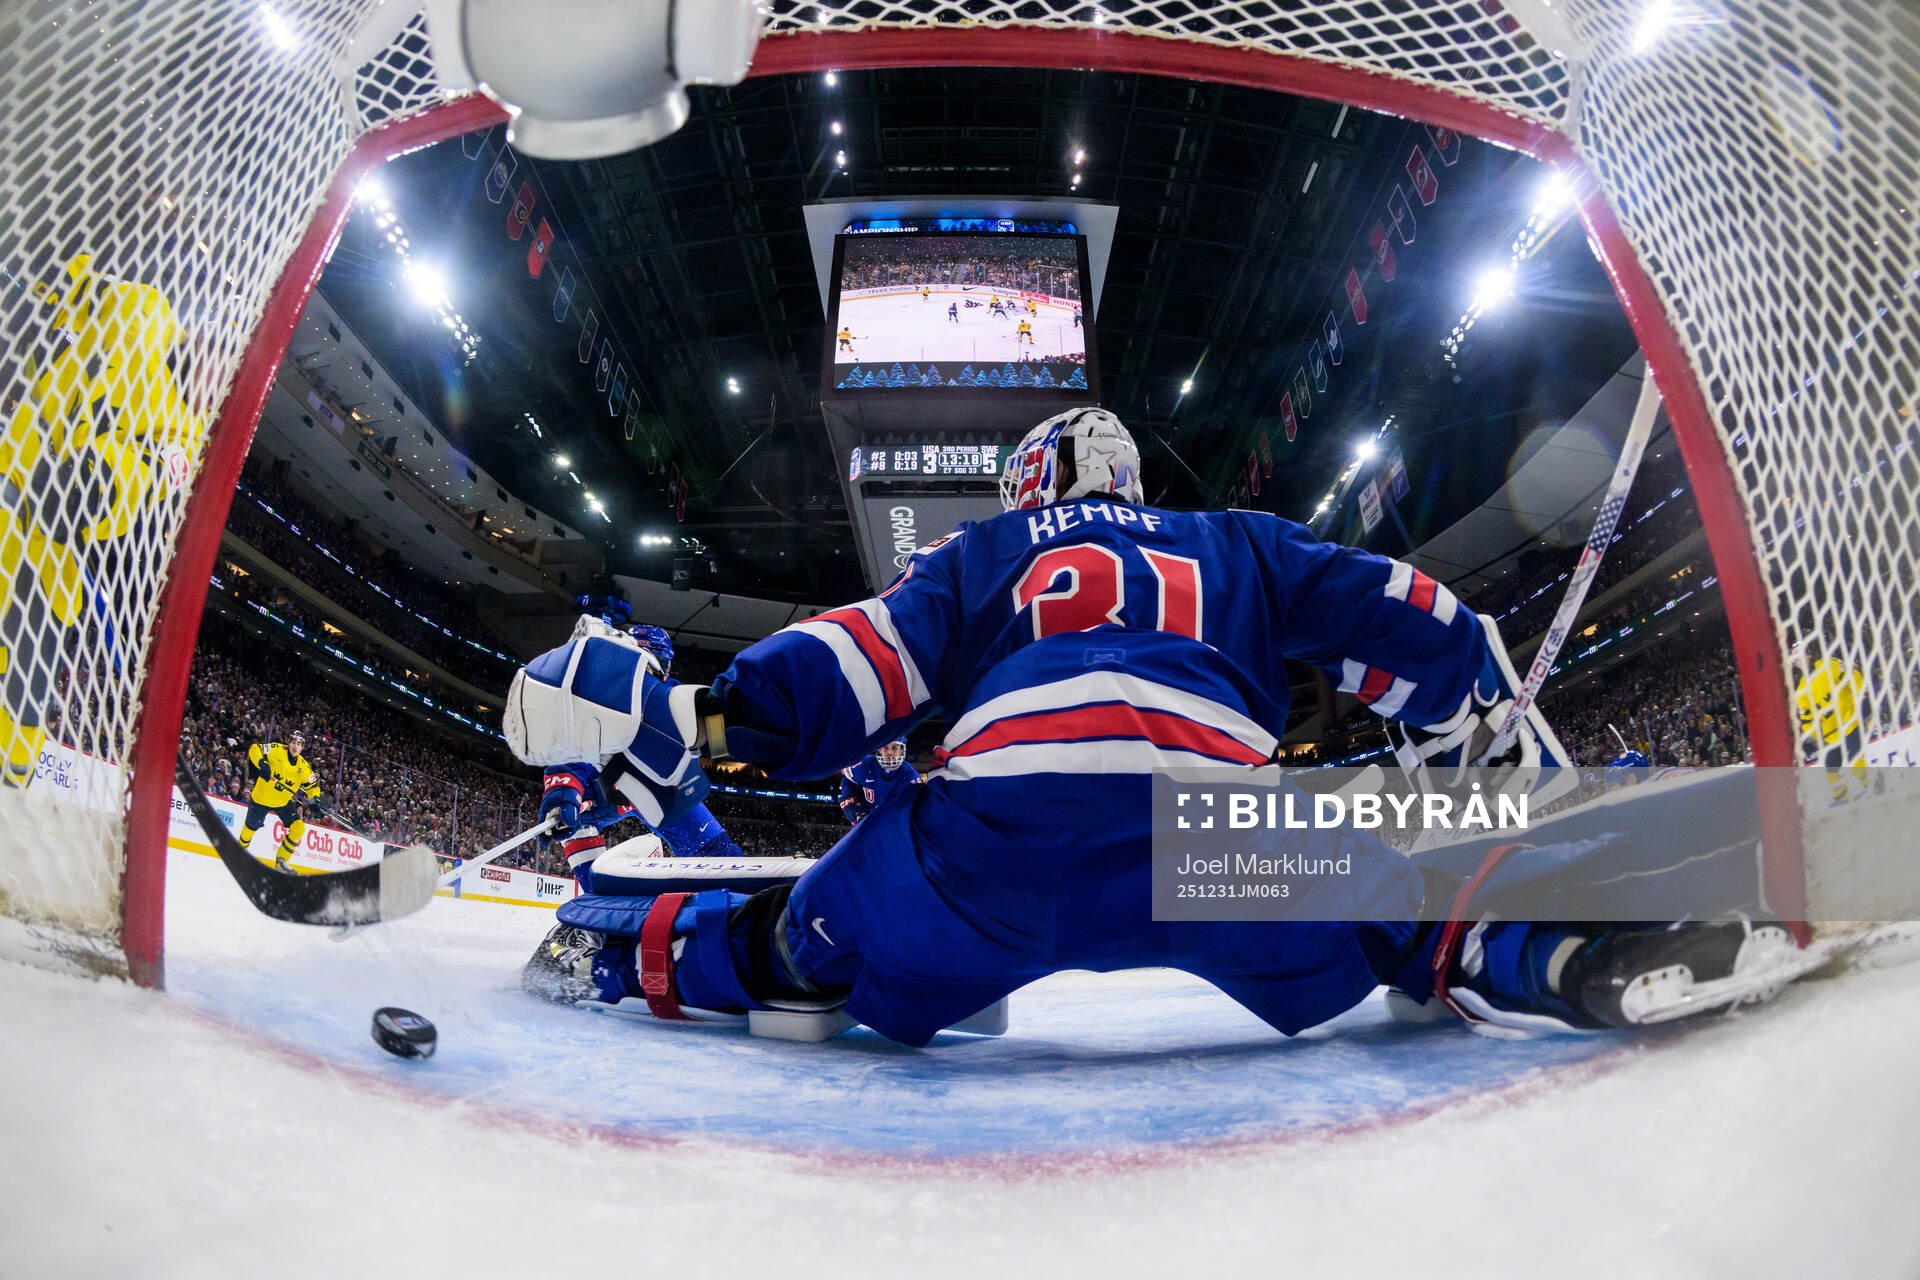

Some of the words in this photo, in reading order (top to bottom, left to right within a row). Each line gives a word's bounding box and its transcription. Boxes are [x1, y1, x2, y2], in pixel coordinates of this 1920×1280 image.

[870, 452, 886, 461] #2
[894, 452, 918, 461] 0:03
[922, 445, 940, 453] USA
[981, 446, 999, 454] SWE
[922, 453, 937, 474] 3
[941, 454, 980, 465] 13:18
[982, 453, 997, 474] 5
[889, 506, 918, 555] GRAND
[1027, 502, 1162, 545] KEMPF
[306, 829, 333, 853] Cub
[338, 836, 363, 860] Cub
[544, 882, 564, 896] IIHF
